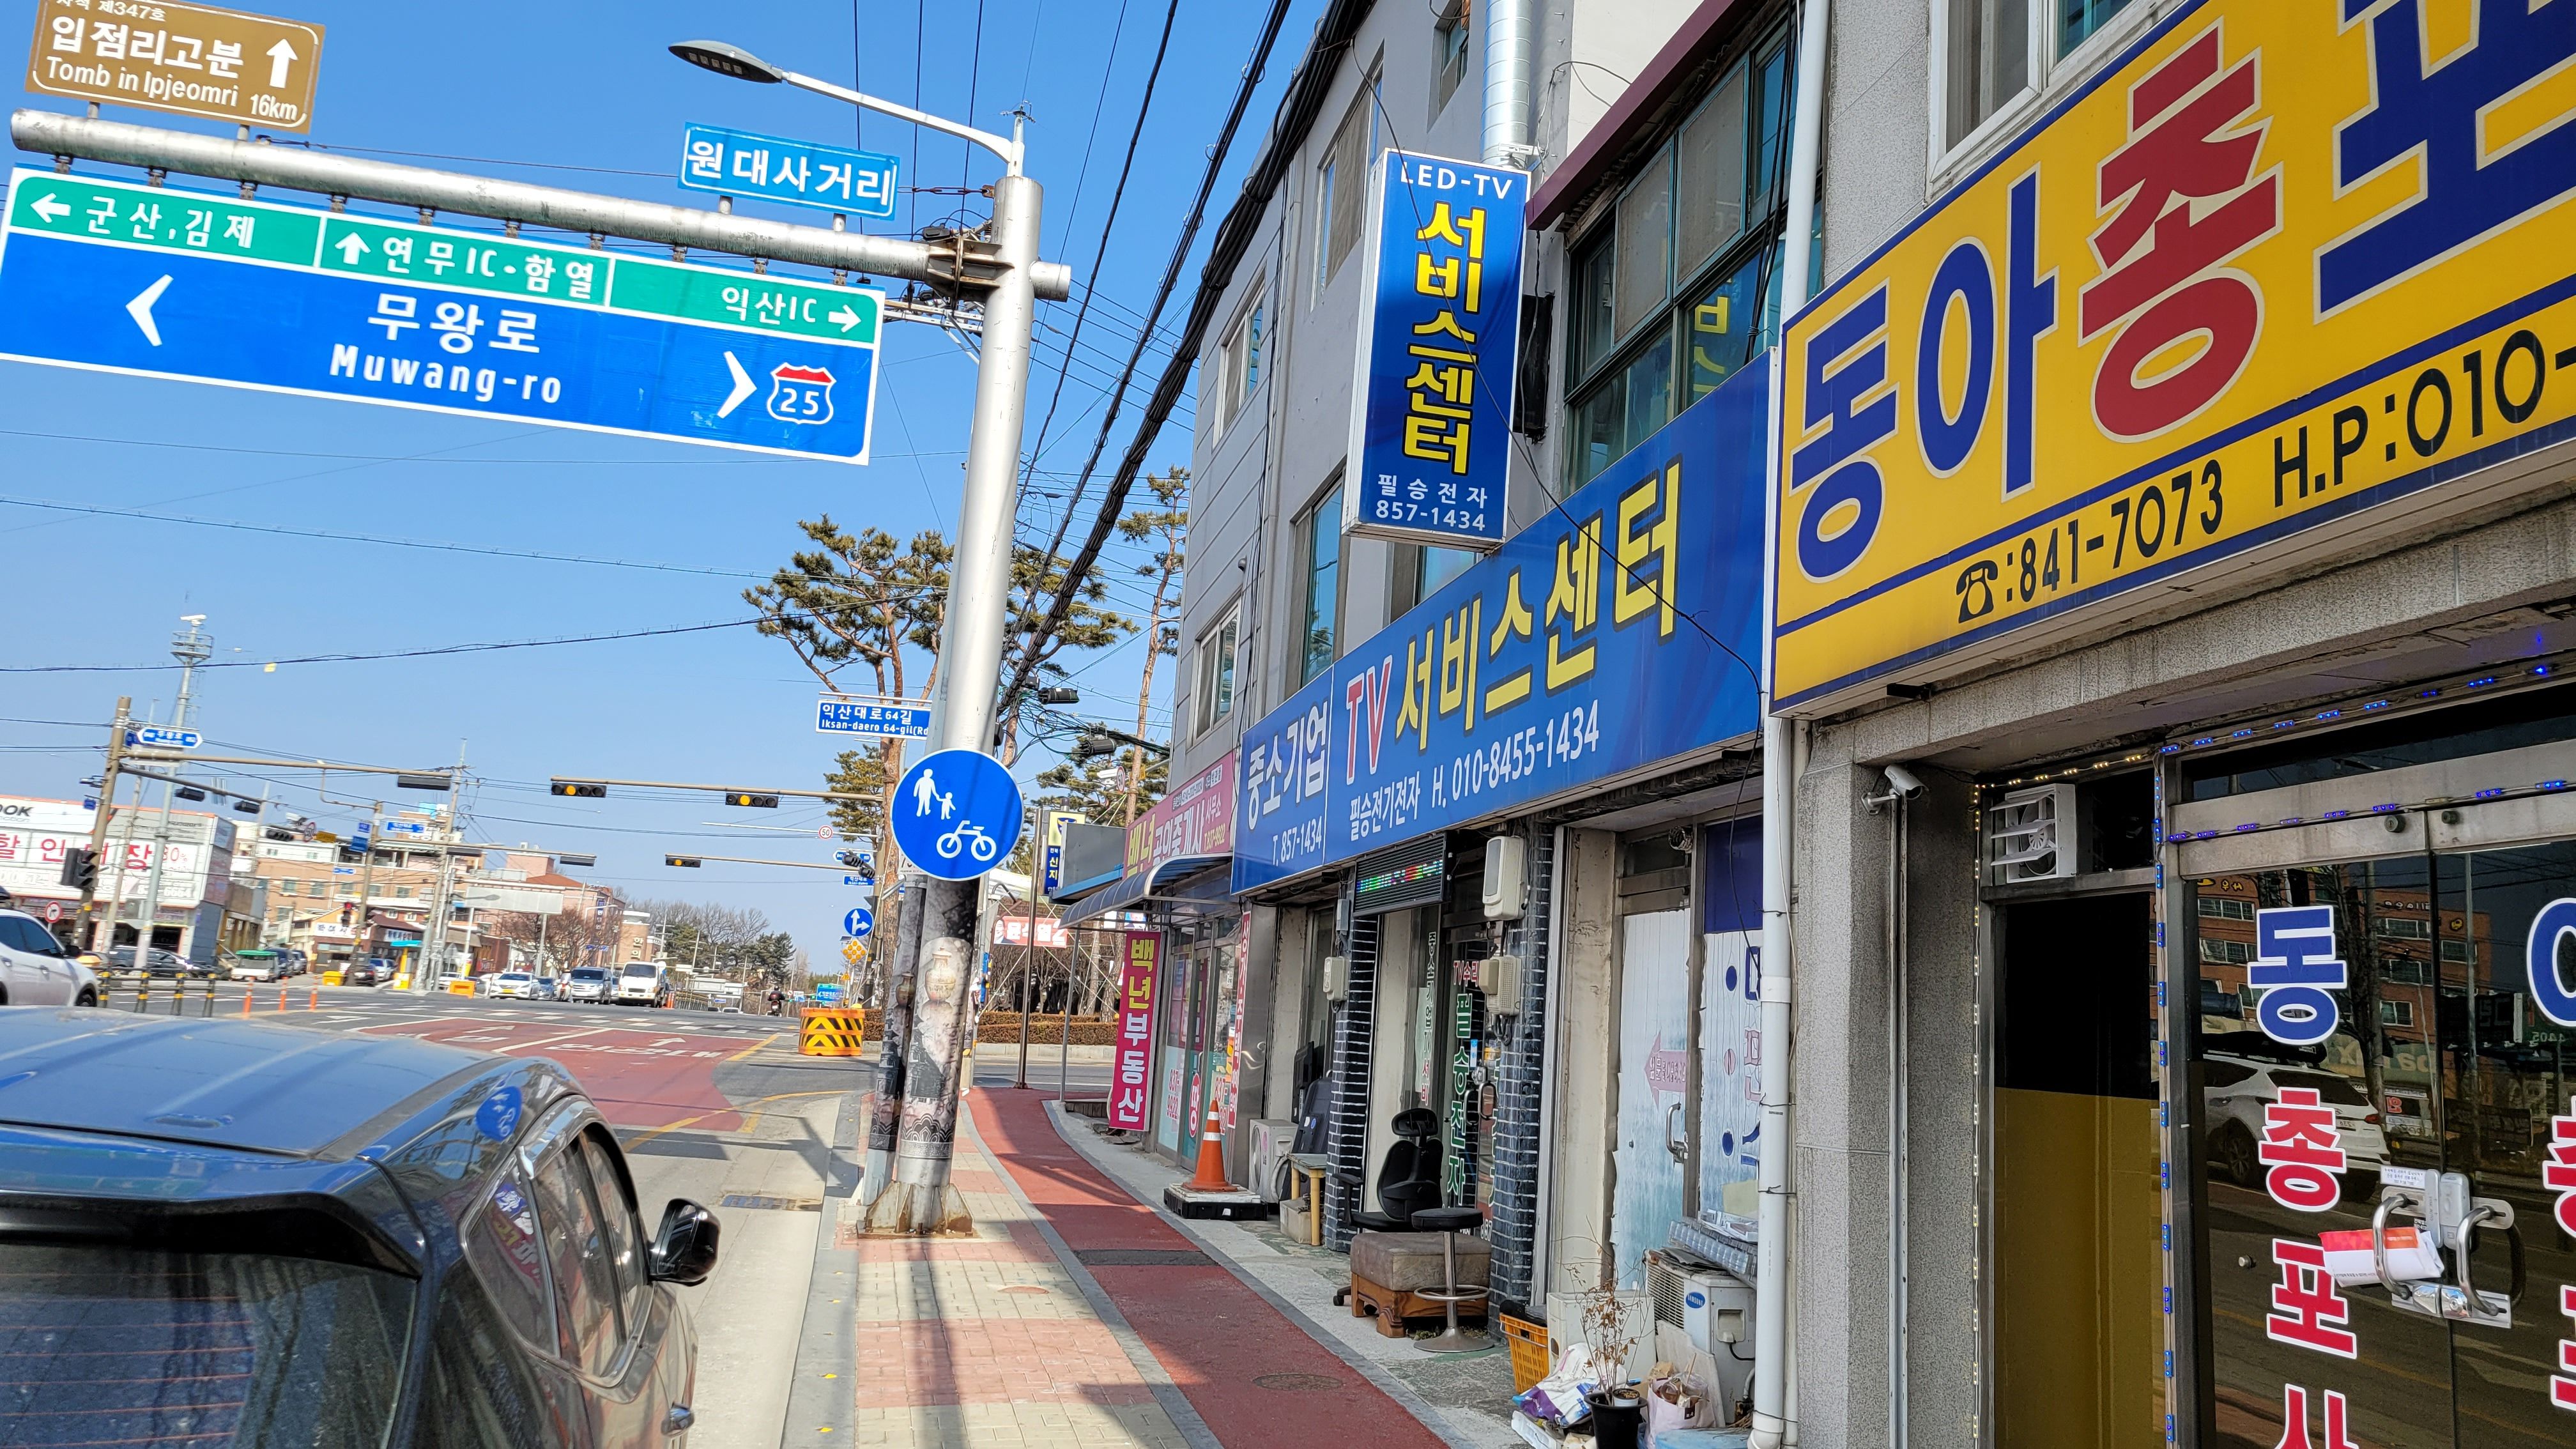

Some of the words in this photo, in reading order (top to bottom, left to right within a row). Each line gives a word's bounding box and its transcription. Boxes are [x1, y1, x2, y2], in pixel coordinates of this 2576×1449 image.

[98, 0, 166, 22] 제347호
[52, 16, 243, 79] 입점리고분
[47, 56, 111, 88] Tomb
[118, 67, 139, 91] in
[143, 71, 238, 107] Ipjeomri
[250, 94, 298, 122] 16km
[687, 141, 891, 206] 원대사거리
[1401, 161, 1512, 199] LED-TV
[367, 293, 540, 355] 무왕로
[721, 286, 817, 326] 익산IC
[1402, 200, 1487, 475] 서비스센터
[329, 344, 562, 404] Muwang-ro
[780, 388, 820, 416] 25
[1376, 499, 1486, 532] 857-1434
[1377, 473, 1488, 509] 필승전자
[822, 719, 880, 732] Iksan-daero
[1248, 699, 1328, 831] 중소기업
[1349, 776, 1421, 843] 필승전기전자
[1453, 699, 1600, 803] 010-8455-1434
[0, 804, 34, 817] OK
[1205, 792, 1222, 824] 사무소
[1117, 939, 1155, 1123] 백년부동산
[1447, 993, 1473, 1206] 필승전자
[1687, 1294, 1704, 1307] SAMSUNG
